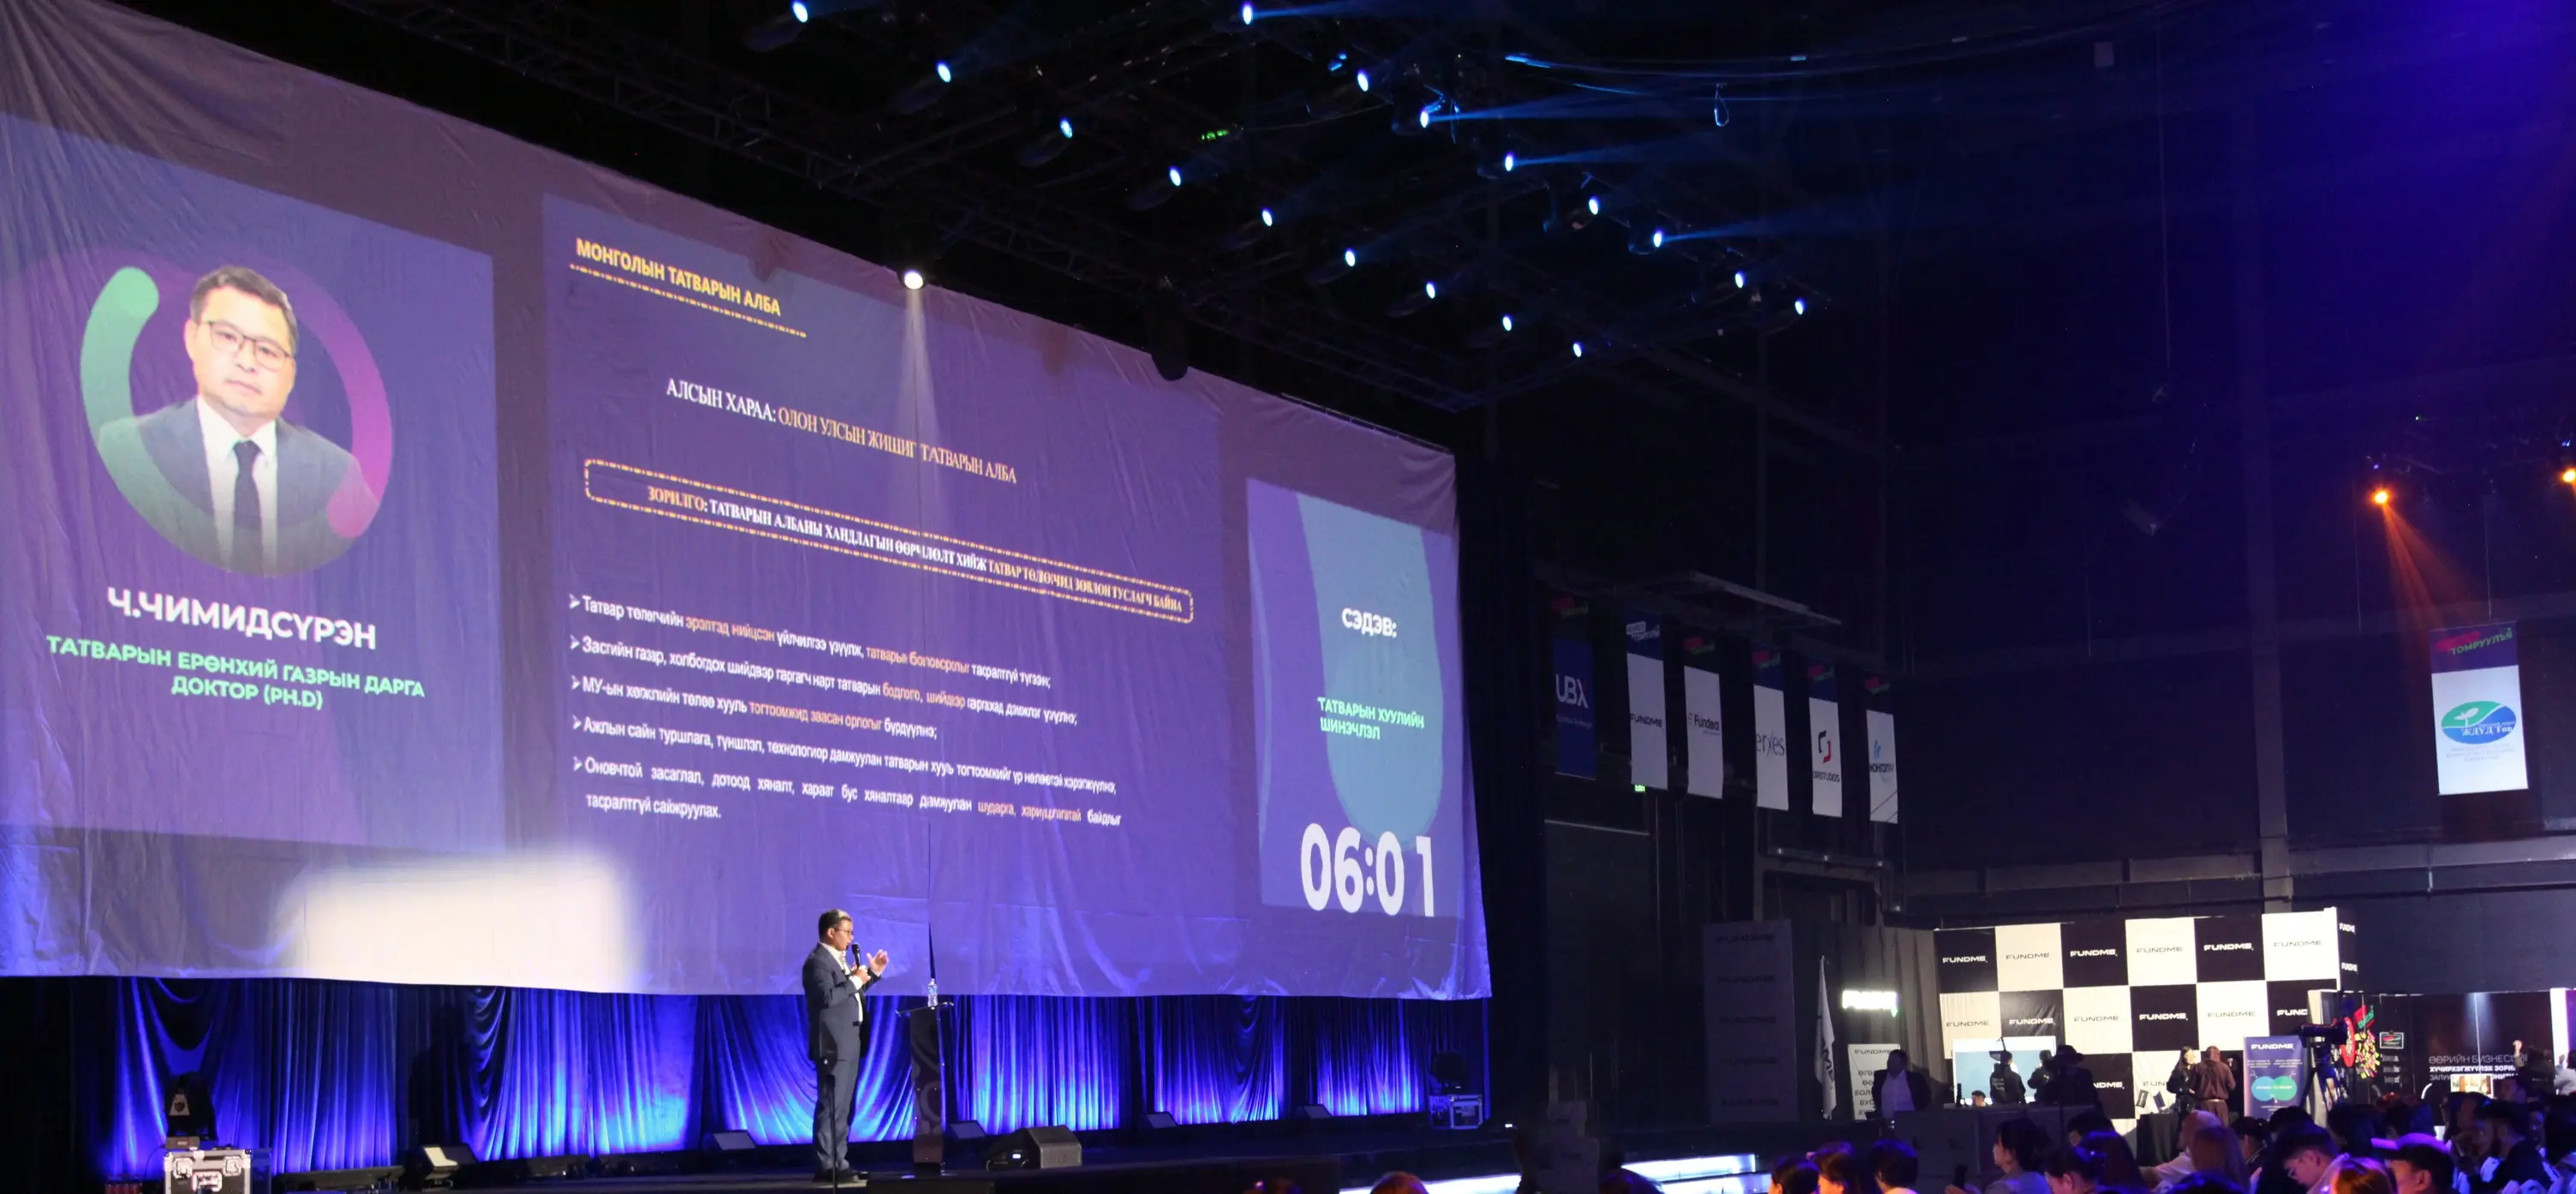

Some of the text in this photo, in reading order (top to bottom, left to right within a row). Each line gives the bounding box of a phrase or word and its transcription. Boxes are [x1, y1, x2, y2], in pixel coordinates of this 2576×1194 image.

[576, 237, 781, 317] МОНГОЛЫН ТАТВАРЫН АЛБА
[666, 378, 1017, 484] АЛСЫН ХАРАА: ОЛОН УЛСЫН ЖИШИГ ТАТВАРЫН АЛБА
[709, 498, 772, 526] ТАТВАРЫН
[774, 514, 822, 537] АЛБАНЫ
[825, 523, 893, 552] ХАНДЛАГЫН
[988, 558, 1022, 579] ТАТВАР
[107, 587, 377, 649] Ч.ЧИМИДСҮРЭН
[582, 594, 624, 620] Татвар
[731, 624, 775, 642] нийцсэн
[1341, 606, 1398, 638] СЭДЭВ:
[46, 635, 426, 698] ТАТВАРЫН ЕРӨНХИЙ ГАЗРЫН ДАРГА
[582, 635, 633, 659] Засгийн
[635, 647, 666, 666] газар,
[669, 652, 725, 673] холбогдох
[727, 660, 774, 682] шийдвэр
[813, 674, 835, 690] нарт
[171, 675, 259, 701] ДОКТОР
[1317, 696, 1425, 730] ТАТВАРЫН ХУУЛИЙН
[1630, 713, 1663, 728] FUNDME
[583, 715, 625, 737] Ажлын
[628, 722, 656, 739] сайн
[1320, 716, 1380, 741] ШИНЭЧЛЭЛ
[585, 755, 643, 778] Оновчтой
[841, 783, 858, 803] бус
[1299, 822, 1435, 918] 06:01
[2006, 952, 2050, 961] FUNDME
[2070, 948, 2116, 958] FUNDME
[2203, 942, 2252, 952] FUNDME
[2273, 940, 2323, 948] FUNDME
[1942, 956, 1986, 964] FUNDME
[2009, 1018, 2054, 1026] FUNDME
[2138, 1012, 2186, 1021] FUNDME
[2251, 1042, 2294, 1051] FUNDME
